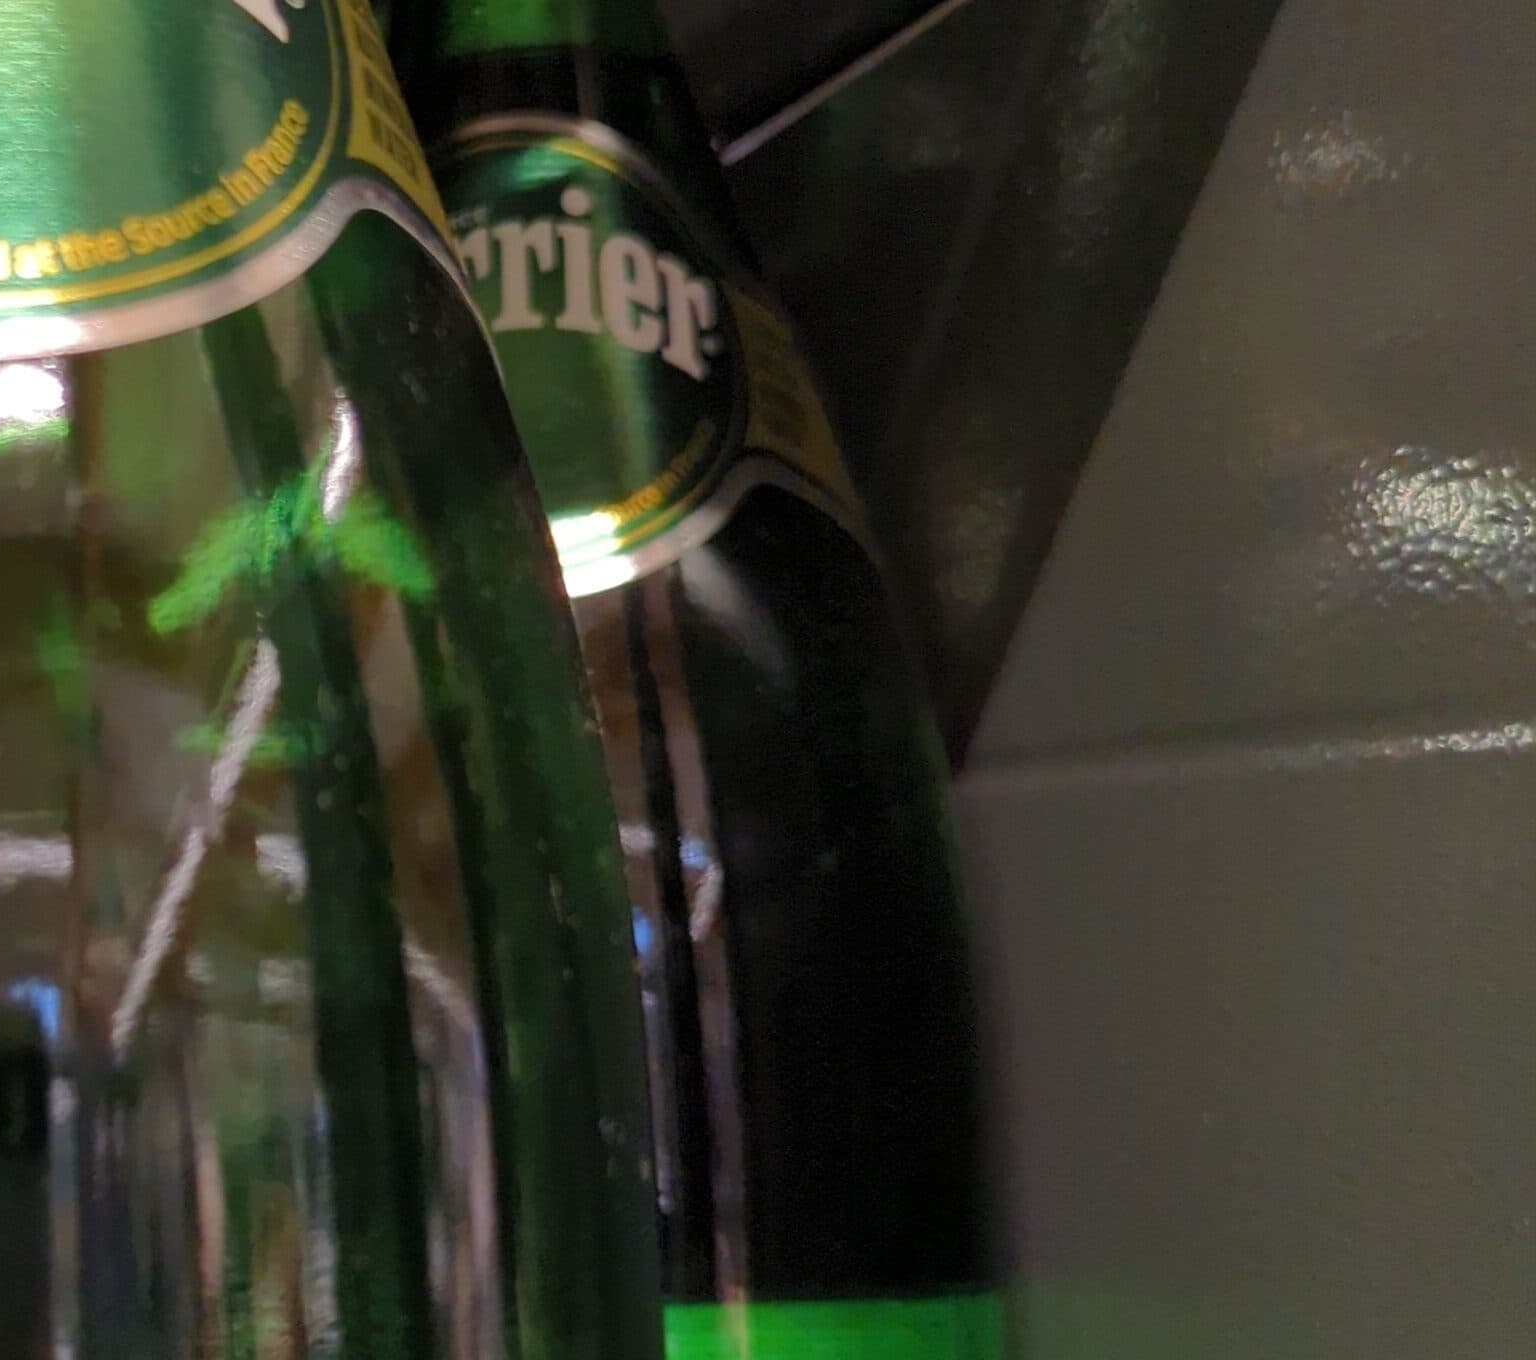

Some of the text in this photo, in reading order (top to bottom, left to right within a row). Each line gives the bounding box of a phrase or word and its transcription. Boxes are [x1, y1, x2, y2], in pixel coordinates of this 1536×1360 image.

[121, 188, 237, 256] Source
[242, 99, 310, 187] France
[460, 187, 718, 382] rier
